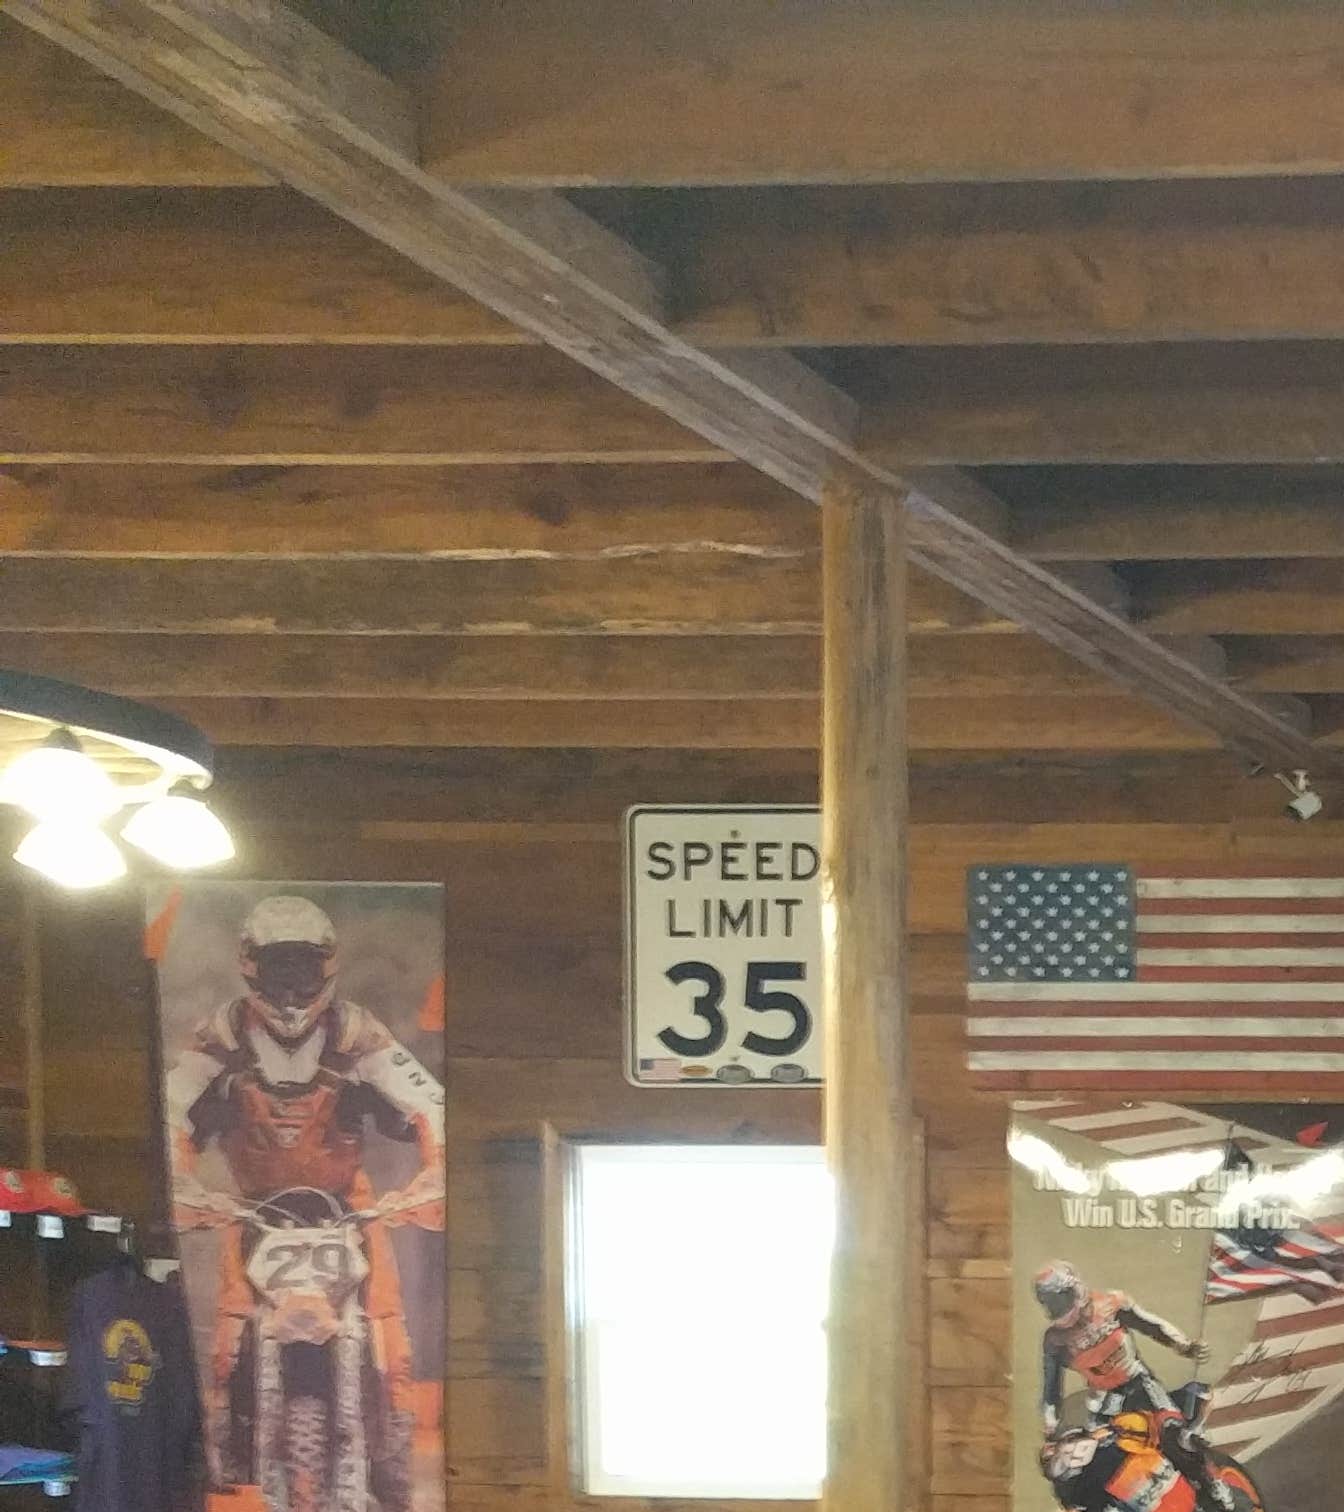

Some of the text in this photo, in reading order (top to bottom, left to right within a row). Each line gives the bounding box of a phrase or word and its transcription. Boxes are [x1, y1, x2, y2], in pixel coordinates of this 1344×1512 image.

[647, 841, 821, 881] SPEED
[667, 898, 803, 938] LIMIT
[656, 960, 813, 1058] 35
[1062, 1197, 1115, 1229] Win
[1118, 1197, 1164, 1229] U.S.
[1165, 1198, 1241, 1230] Grand
